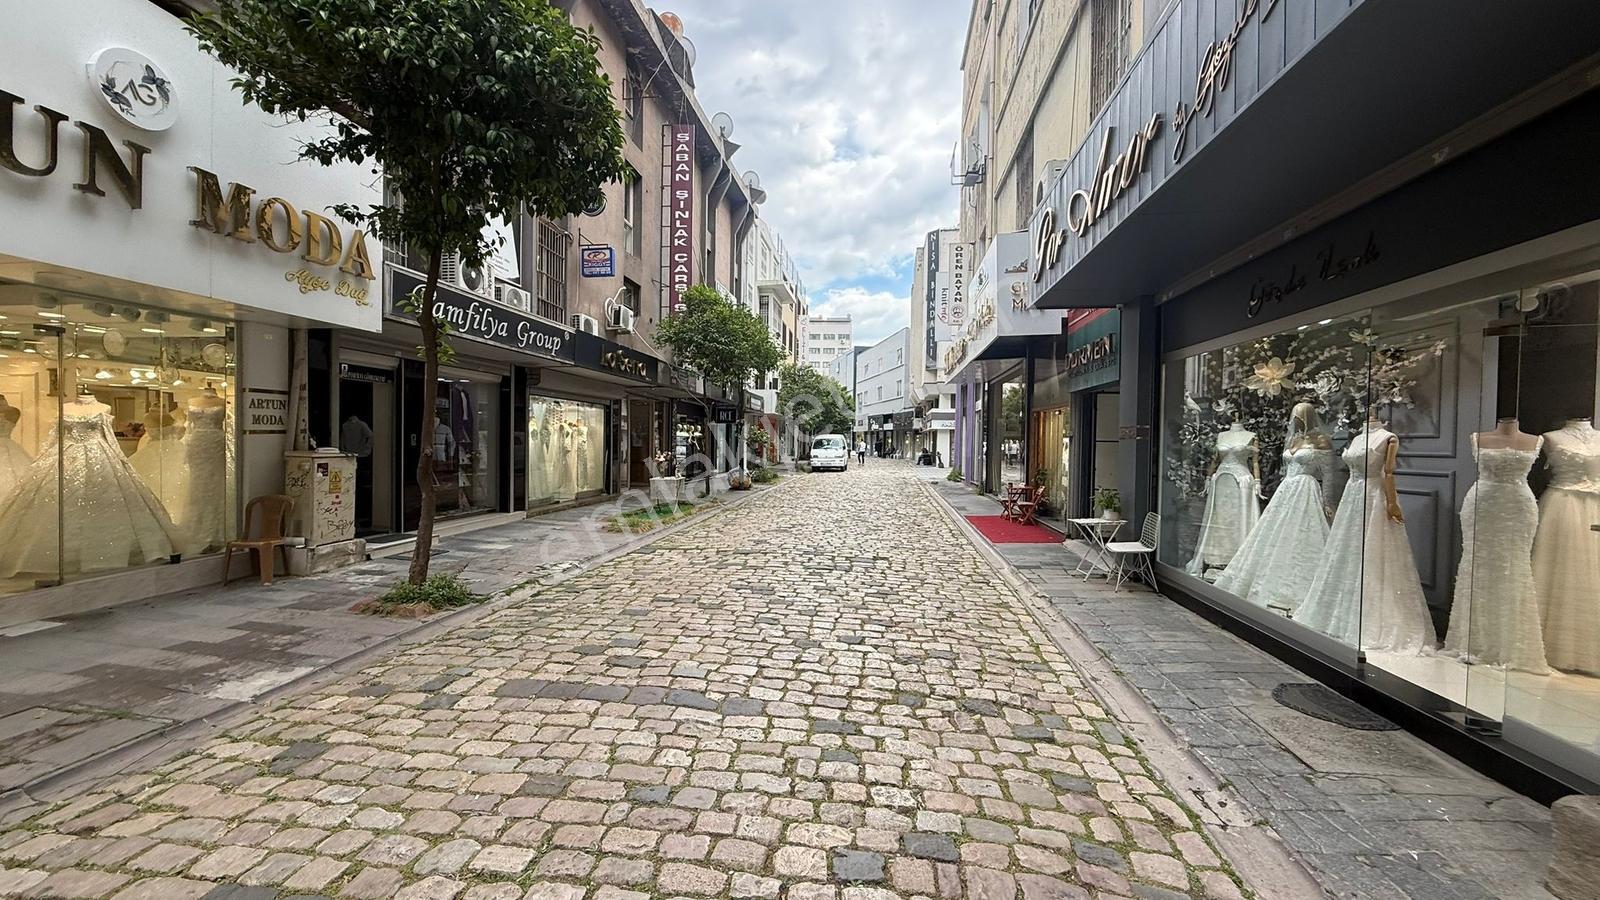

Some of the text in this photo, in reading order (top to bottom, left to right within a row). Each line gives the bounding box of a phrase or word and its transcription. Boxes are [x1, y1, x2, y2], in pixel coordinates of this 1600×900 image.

[186, 166, 376, 280] MODA
[517, 321, 561, 357] Group
[249, 398, 287, 411] ARTUN
[252, 414, 285, 426] MODA
